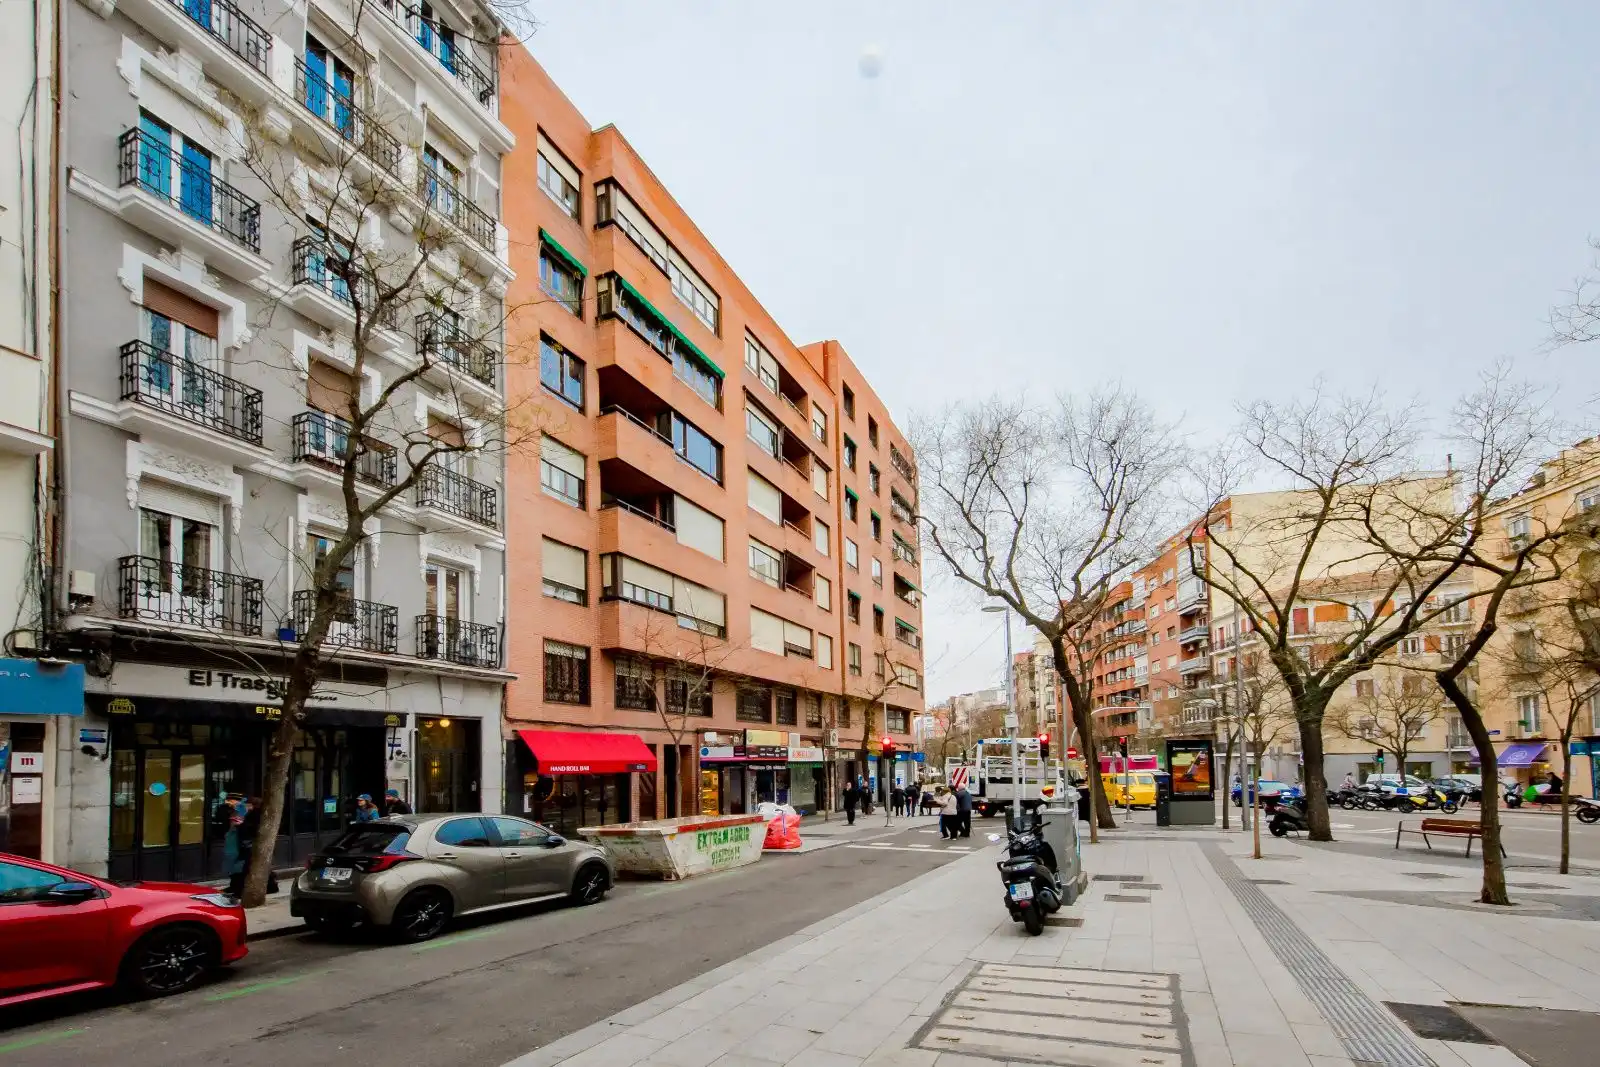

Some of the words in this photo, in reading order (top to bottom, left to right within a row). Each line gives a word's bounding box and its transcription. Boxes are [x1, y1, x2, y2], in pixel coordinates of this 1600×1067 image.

[189, 669, 212, 687] El
[256, 706, 265, 714] El
[266, 707, 282, 716] Tra
